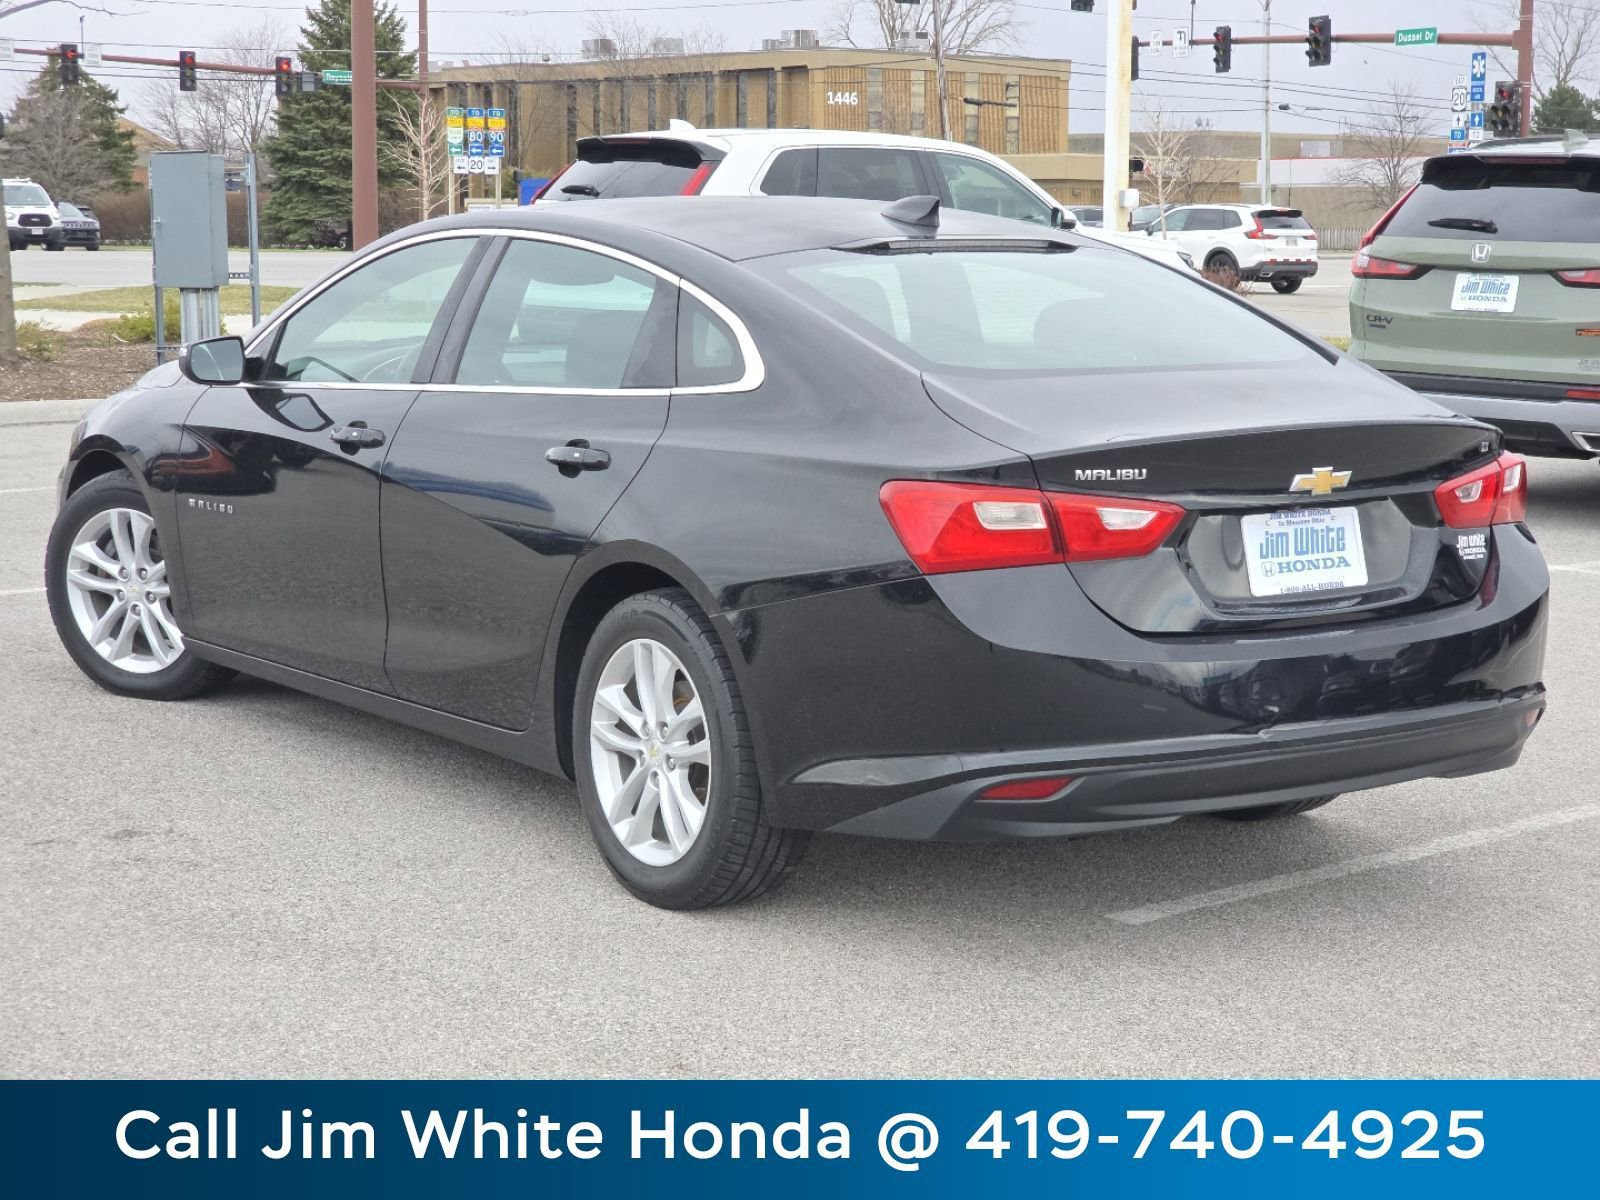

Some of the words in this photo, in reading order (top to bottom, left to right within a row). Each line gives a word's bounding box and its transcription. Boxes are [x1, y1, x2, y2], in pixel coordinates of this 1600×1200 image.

[1398, 32, 1422, 42] Dussel
[1425, 31, 1434, 41] Dr
[827, 91, 859, 105] 1446
[1453, 93, 1465, 106] 20
[469, 131, 483, 142] 80
[489, 132, 503, 142] 90
[470, 159, 483, 170] 20
[1480, 280, 1511, 295] White
[1366, 314, 1394, 324] CR-V
[1074, 468, 1147, 481] MALIBU
[188, 498, 234, 514] MALIBU
[1259, 530, 1289, 560] Jim
[1294, 525, 1346, 556] White
[1277, 556, 1351, 574] HONDA
